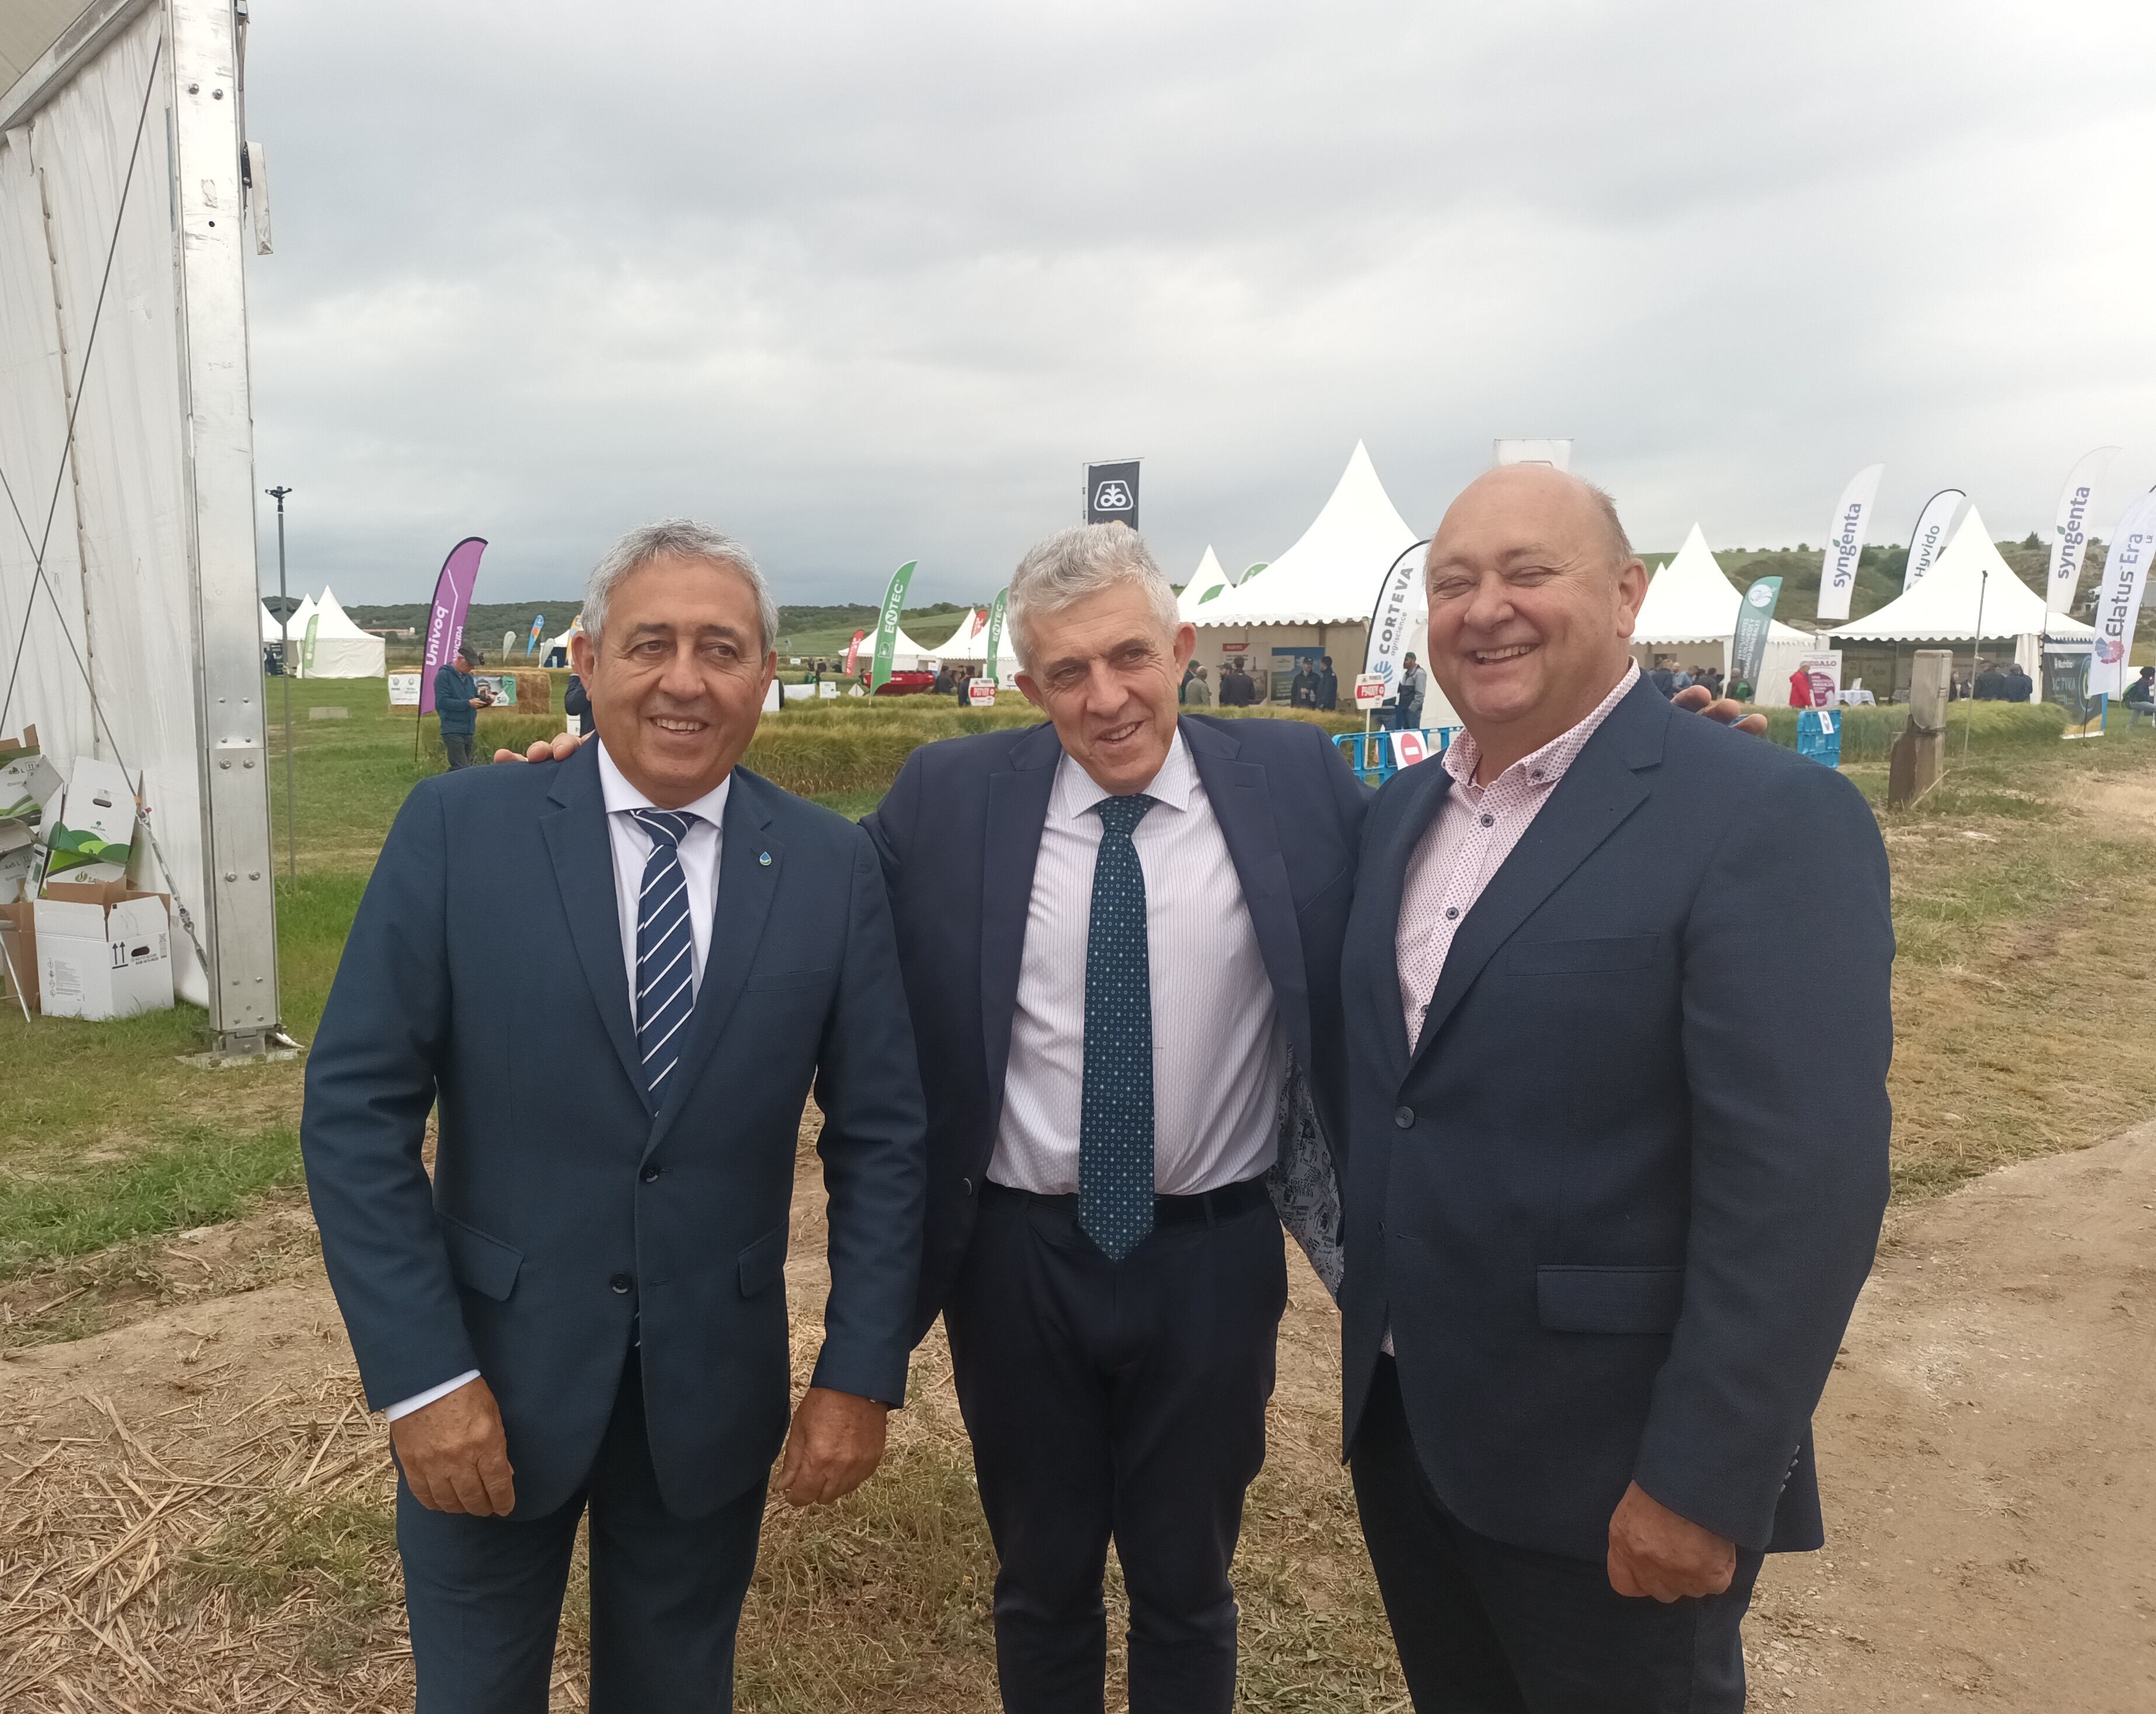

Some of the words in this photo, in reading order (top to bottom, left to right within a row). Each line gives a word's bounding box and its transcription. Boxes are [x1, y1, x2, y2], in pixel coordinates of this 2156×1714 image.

[1833, 504, 1862, 587] syngenta
[1914, 525, 1940, 577] Hyvido
[2058, 487, 2090, 579] syngenta
[2119, 534, 2143, 564] Era
[884, 583, 903, 634] ENTEC
[1379, 567, 1413, 655] CORTEVA
[1391, 612, 1407, 656] agriscience
[2106, 571, 2134, 636] Elatus
[425, 605, 449, 666] Univoq
